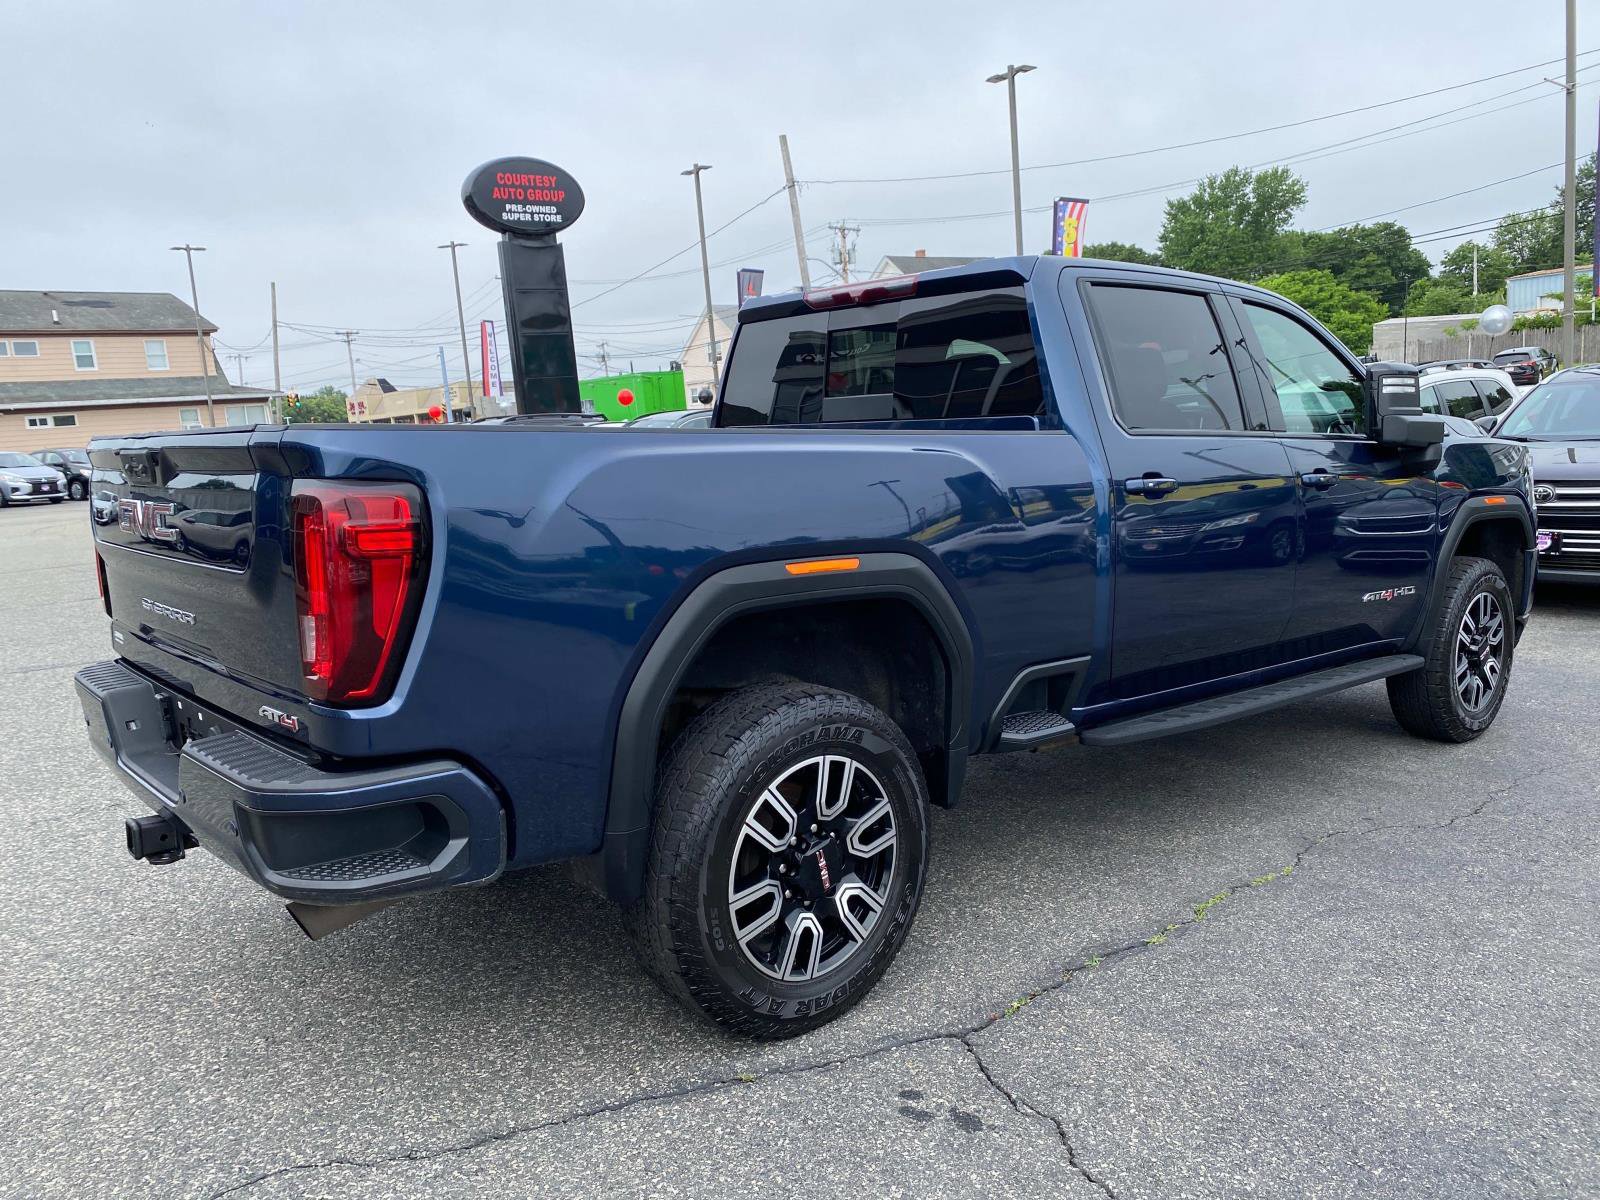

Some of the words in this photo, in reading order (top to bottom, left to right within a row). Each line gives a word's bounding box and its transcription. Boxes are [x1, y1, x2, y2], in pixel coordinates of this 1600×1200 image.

[496, 172, 557, 187] COURTESY
[492, 187, 524, 200] AUTO
[527, 189, 566, 202] GROUP
[505, 203, 557, 214] PRE-OWNED
[502, 212, 532, 222] SUPER
[533, 213, 562, 223] STORE
[118, 499, 180, 541] GMC
[141, 597, 197, 625] SIERRA
[258, 705, 300, 733] AT4
[738, 726, 865, 796] YOKOHAMA
[816, 849, 831, 890] GMC
